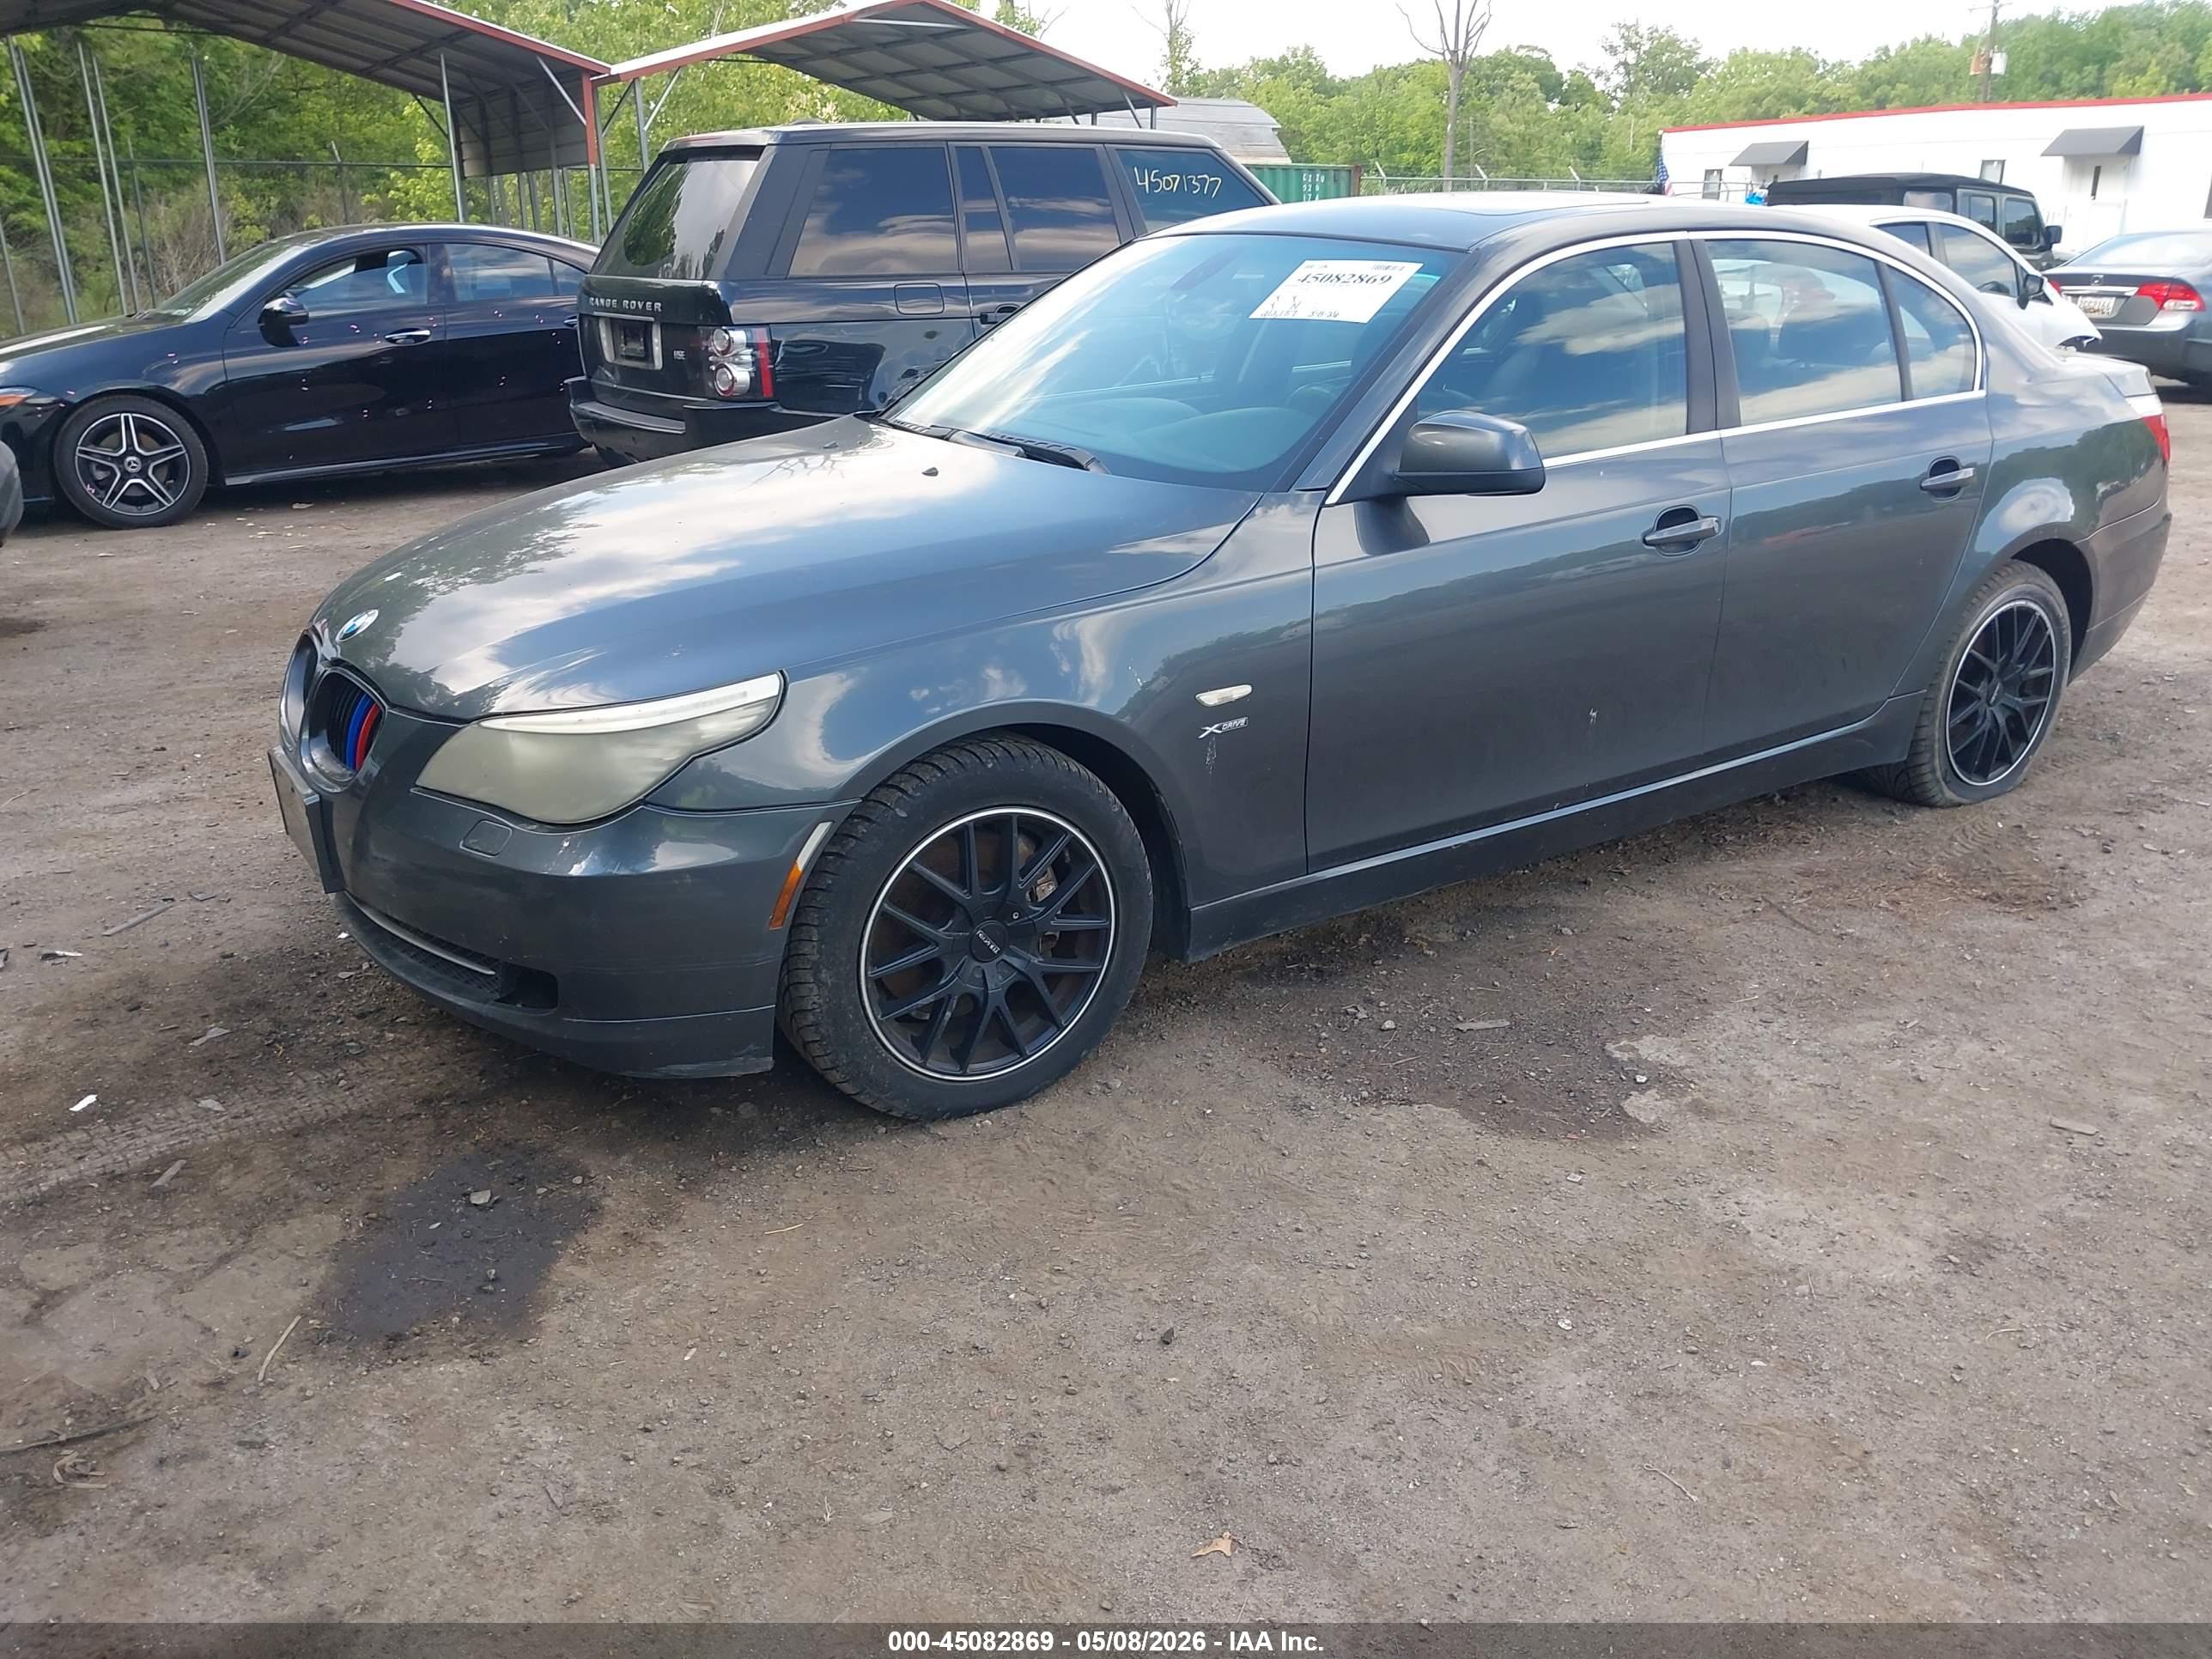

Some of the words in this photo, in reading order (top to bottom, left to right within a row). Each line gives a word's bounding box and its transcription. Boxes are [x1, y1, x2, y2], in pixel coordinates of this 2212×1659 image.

[1133, 166, 1222, 199] 45071377
[1296, 272, 1393, 286] 45082869
[589, 297, 617, 308] RANGE
[623, 300, 662, 312] ROVER
